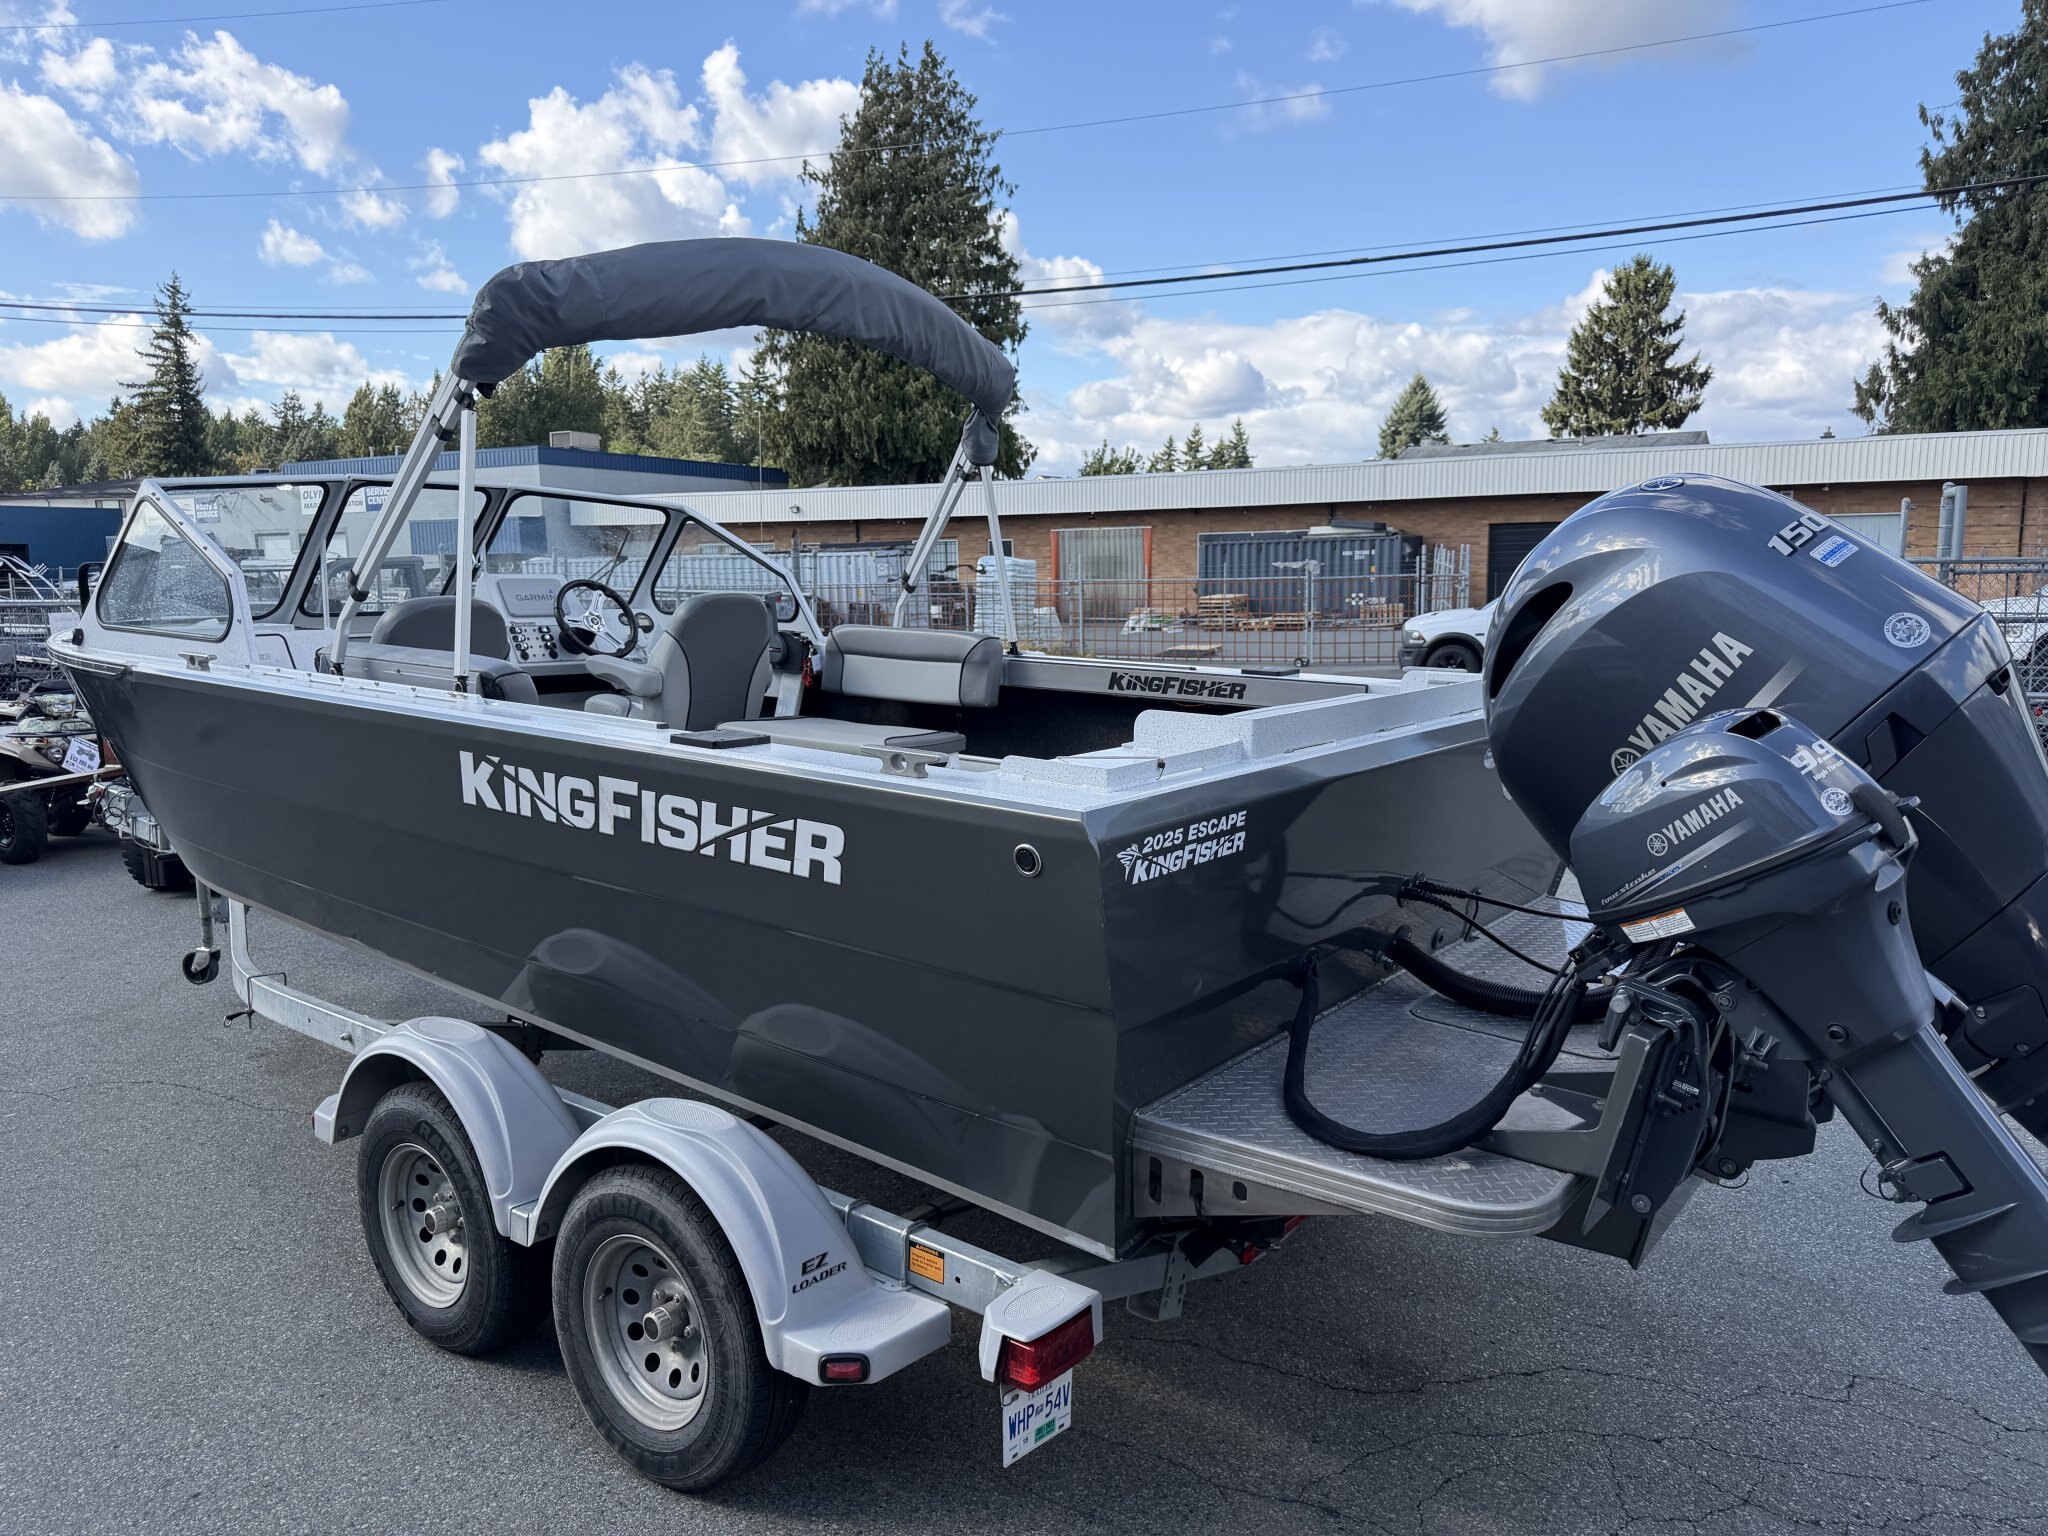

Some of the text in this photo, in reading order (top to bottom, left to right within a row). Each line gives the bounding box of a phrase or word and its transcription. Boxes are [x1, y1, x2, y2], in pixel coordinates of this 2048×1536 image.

[366, 487, 390, 497] SERVIC
[196, 510, 219, 518] SERVICE
[1767, 512, 1830, 557] 150
[515, 593, 556, 602] GARMIN
[1107, 671, 1247, 700] KINGFISHER
[1627, 631, 1754, 751] YAMAHA
[1790, 740, 1836, 776] 9.9
[1813, 766, 1829, 781] High
[459, 750, 846, 886] KINGFISHER
[1141, 810, 1247, 854] 2025 ESCAPE
[1662, 787, 1744, 846] YAMAHA
[1131, 831, 1247, 885] KINGFISHER
[792, 1261, 847, 1294] LOADER
[801, 1251, 829, 1277] EZ
[1008, 1403, 1035, 1441] WHP
[1044, 1381, 1071, 1419] 54V
